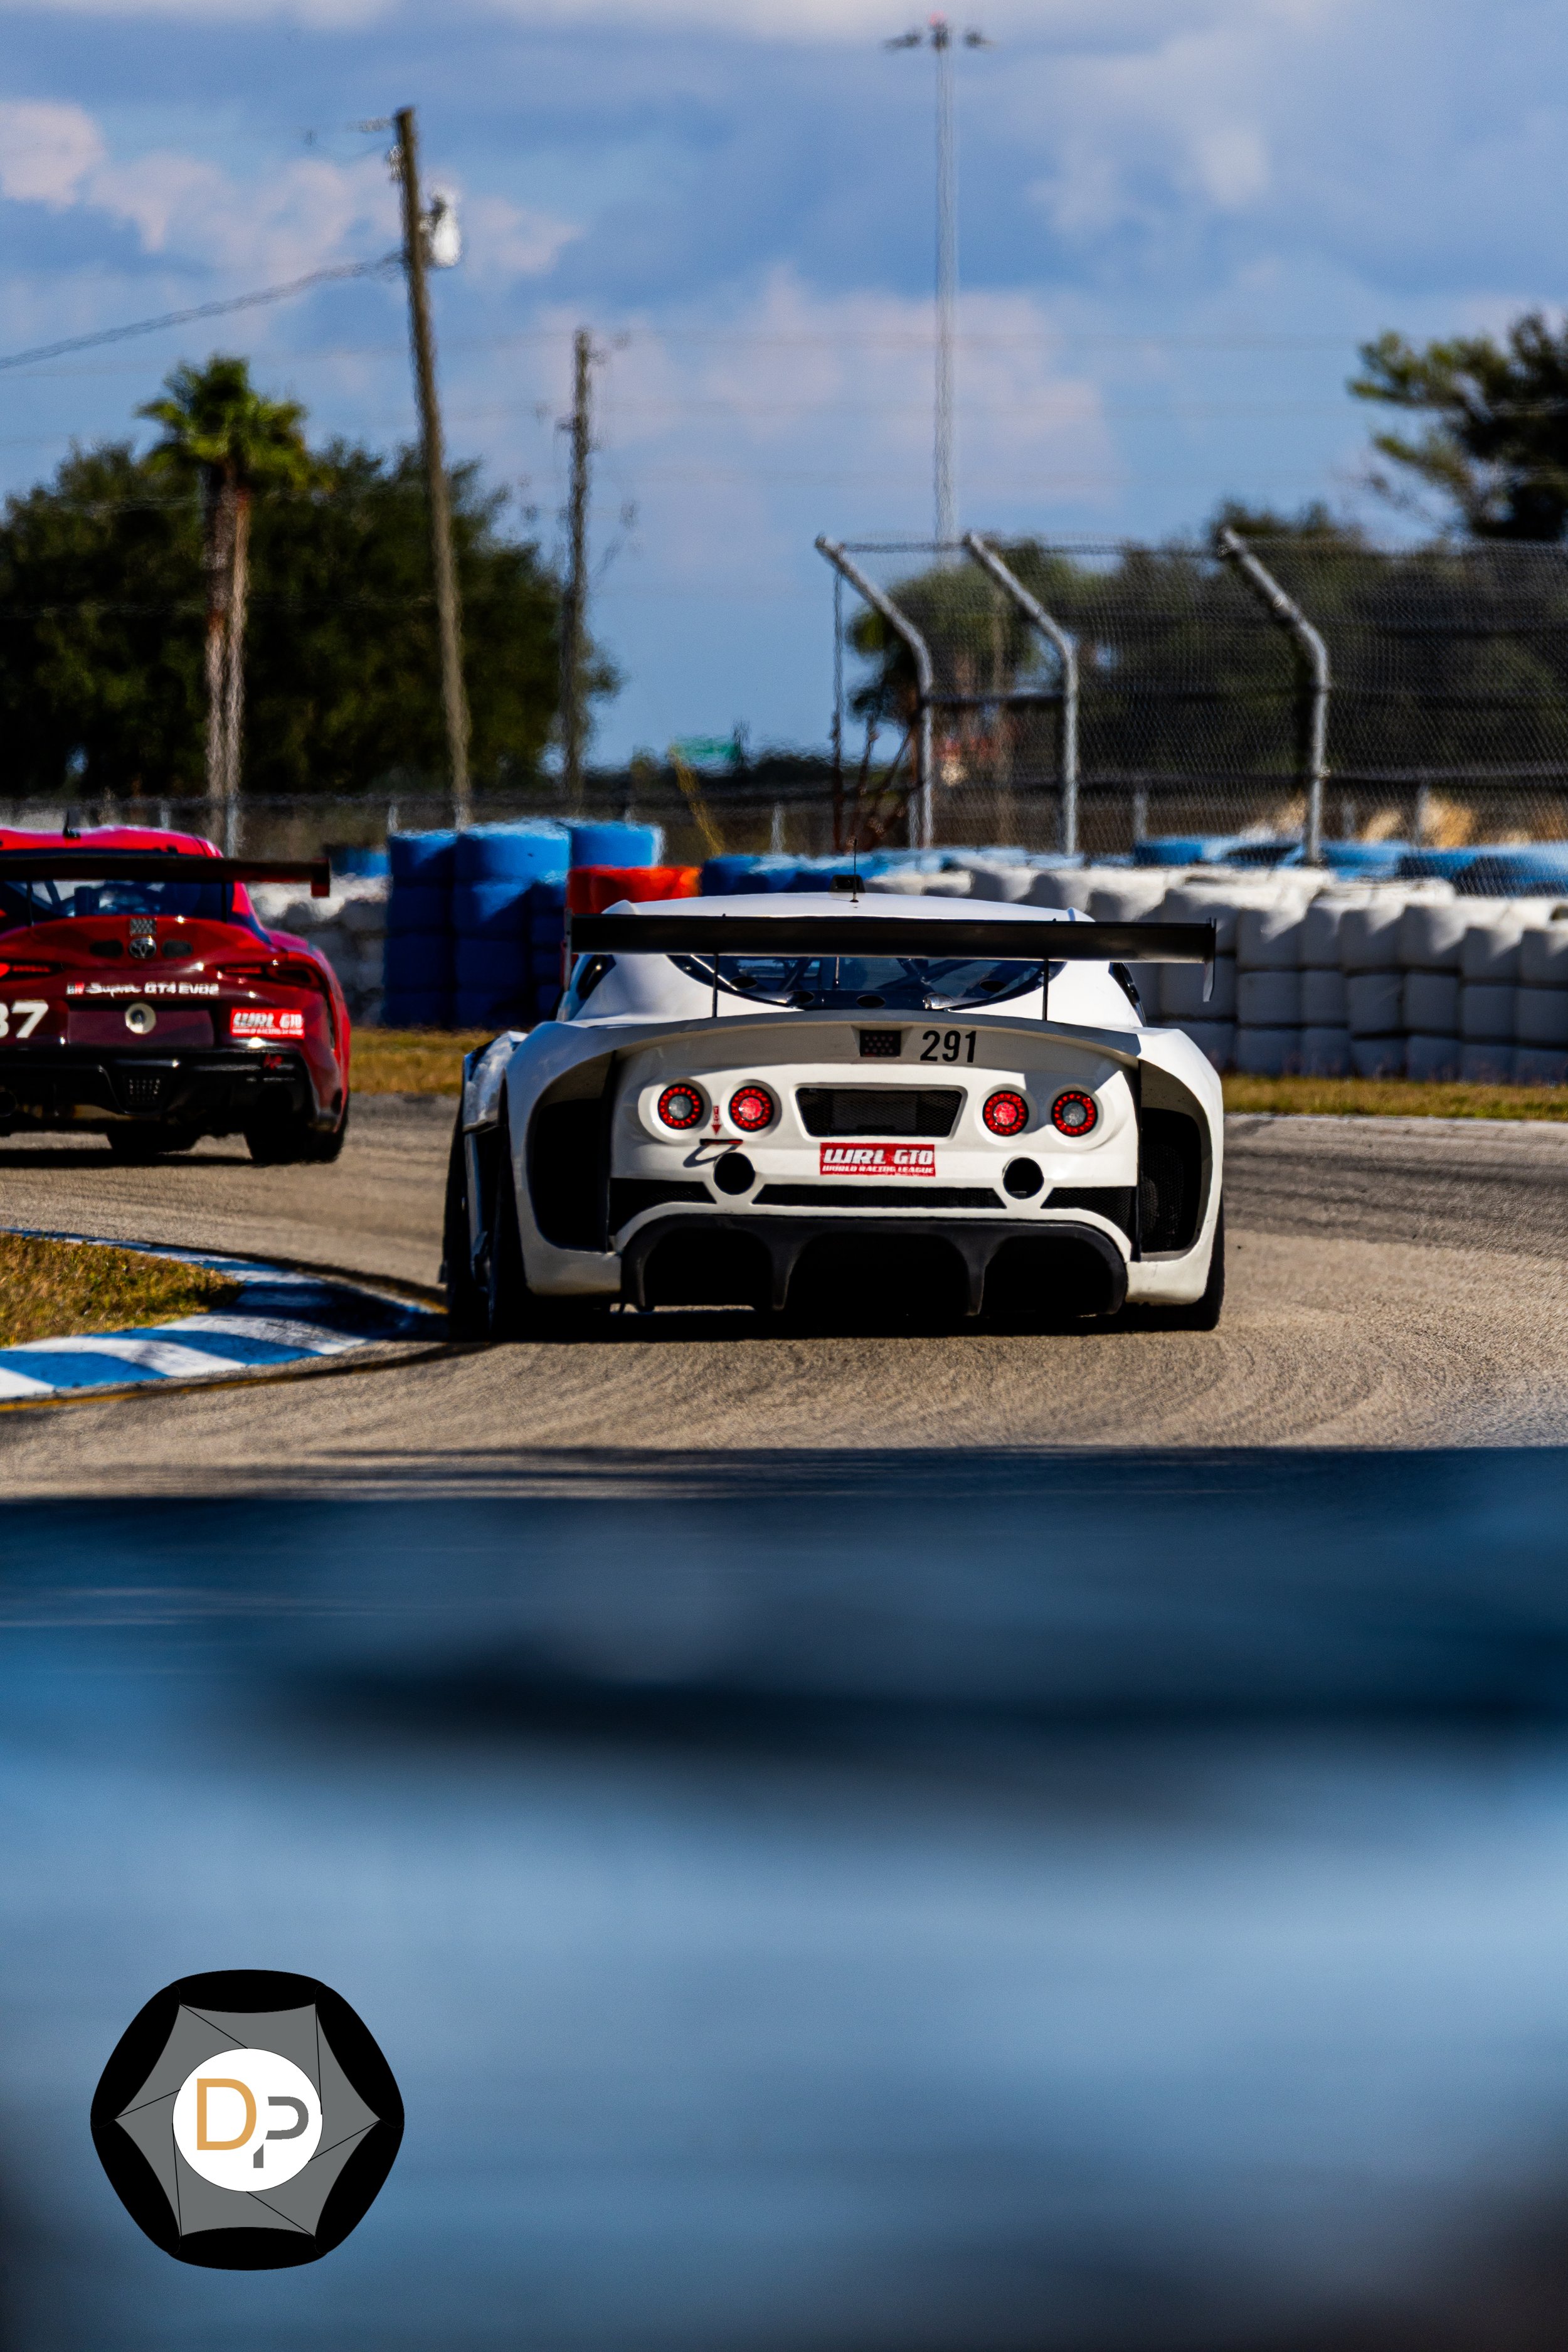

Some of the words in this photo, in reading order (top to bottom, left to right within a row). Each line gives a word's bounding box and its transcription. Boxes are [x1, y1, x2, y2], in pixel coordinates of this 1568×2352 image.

[85, 982, 141, 998] Supra
[144, 982, 176, 993] GT4
[179, 982, 219, 995] EVO2
[0, 1000, 48, 1038] 7
[919, 1030, 977, 1062] 291
[823, 1149, 886, 1164] WRL
[893, 1150, 933, 1165] GTO
